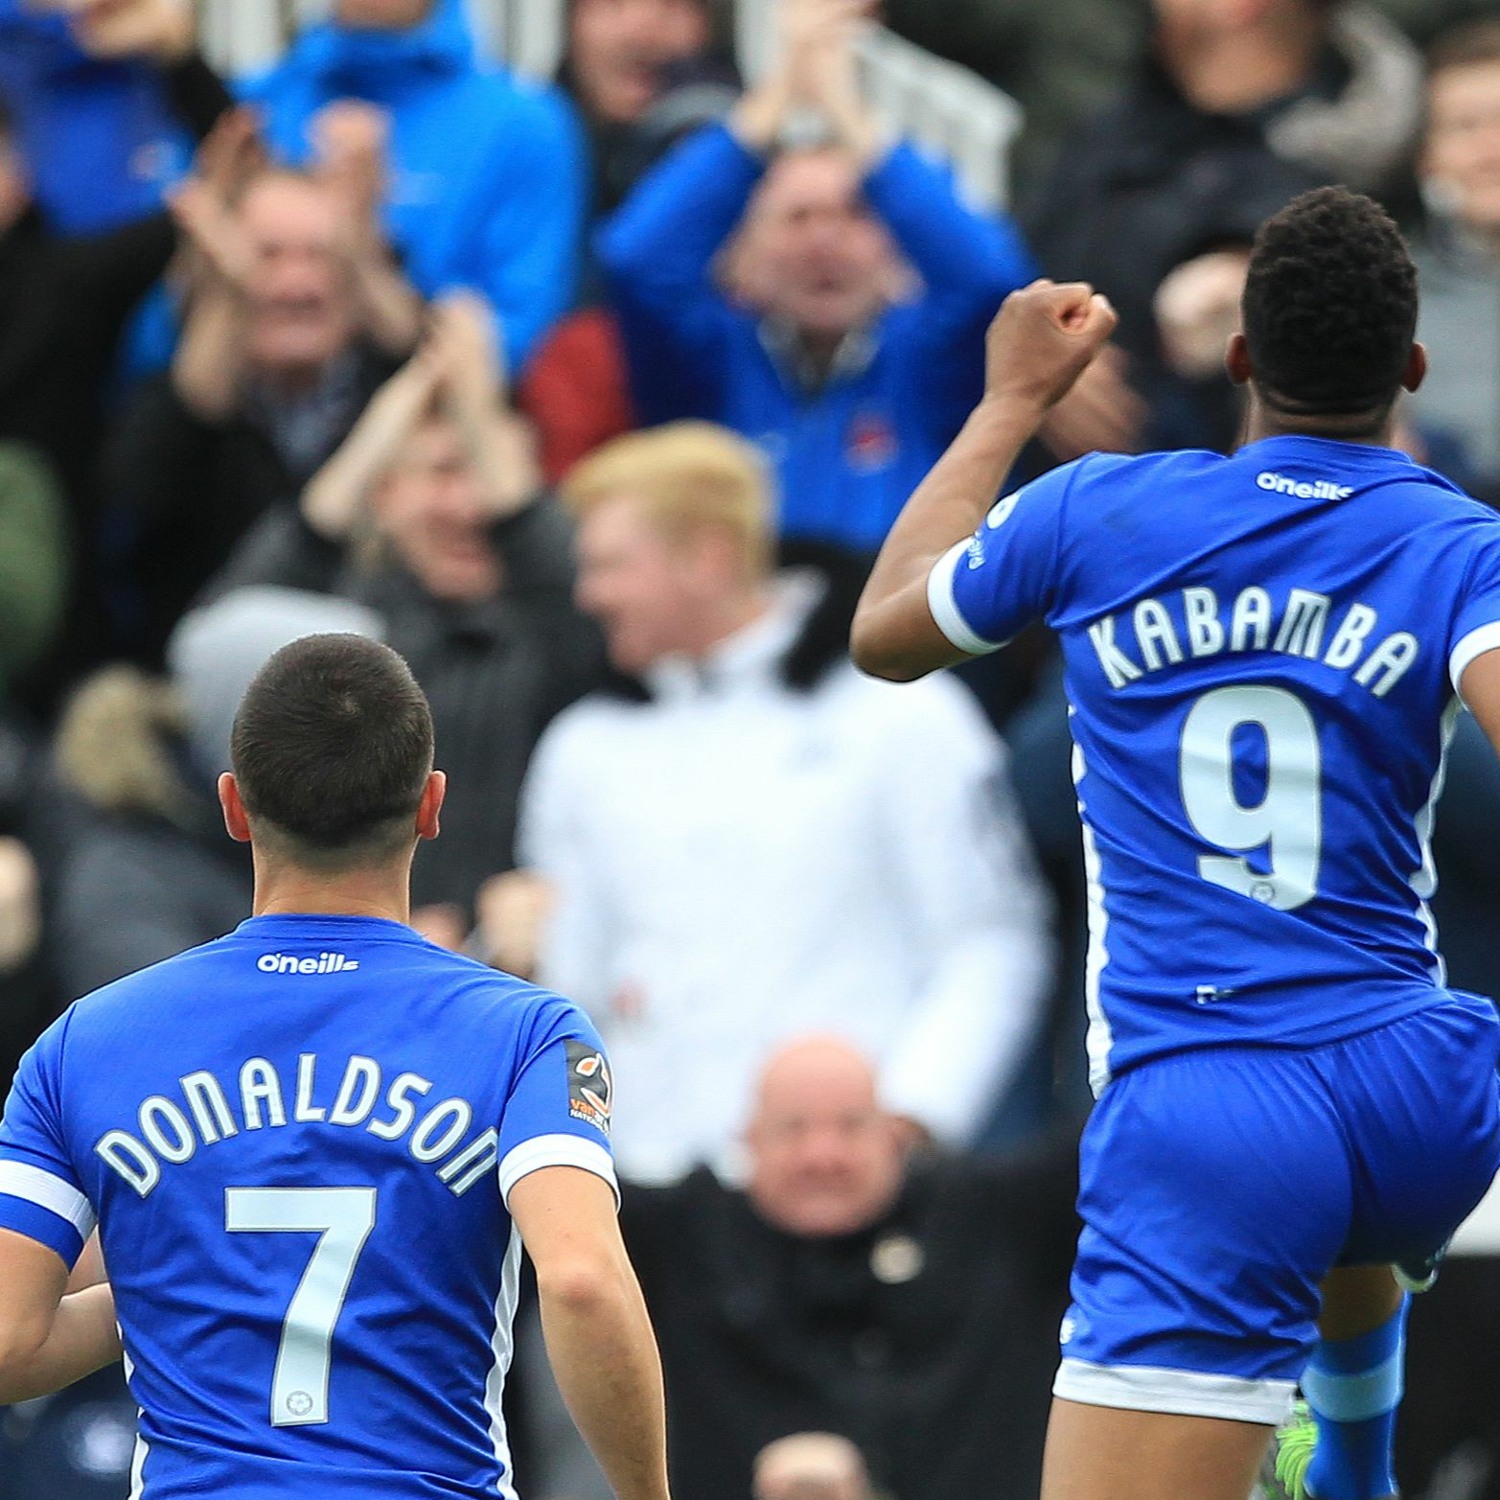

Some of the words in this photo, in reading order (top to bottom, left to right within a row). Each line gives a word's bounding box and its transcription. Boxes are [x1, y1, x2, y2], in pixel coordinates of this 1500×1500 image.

[1087, 585, 1419, 698] KABAMBA
[1179, 684, 1322, 911] 9
[94, 1052, 501, 1199] DONALDSON
[224, 1186, 378, 1428] 7
